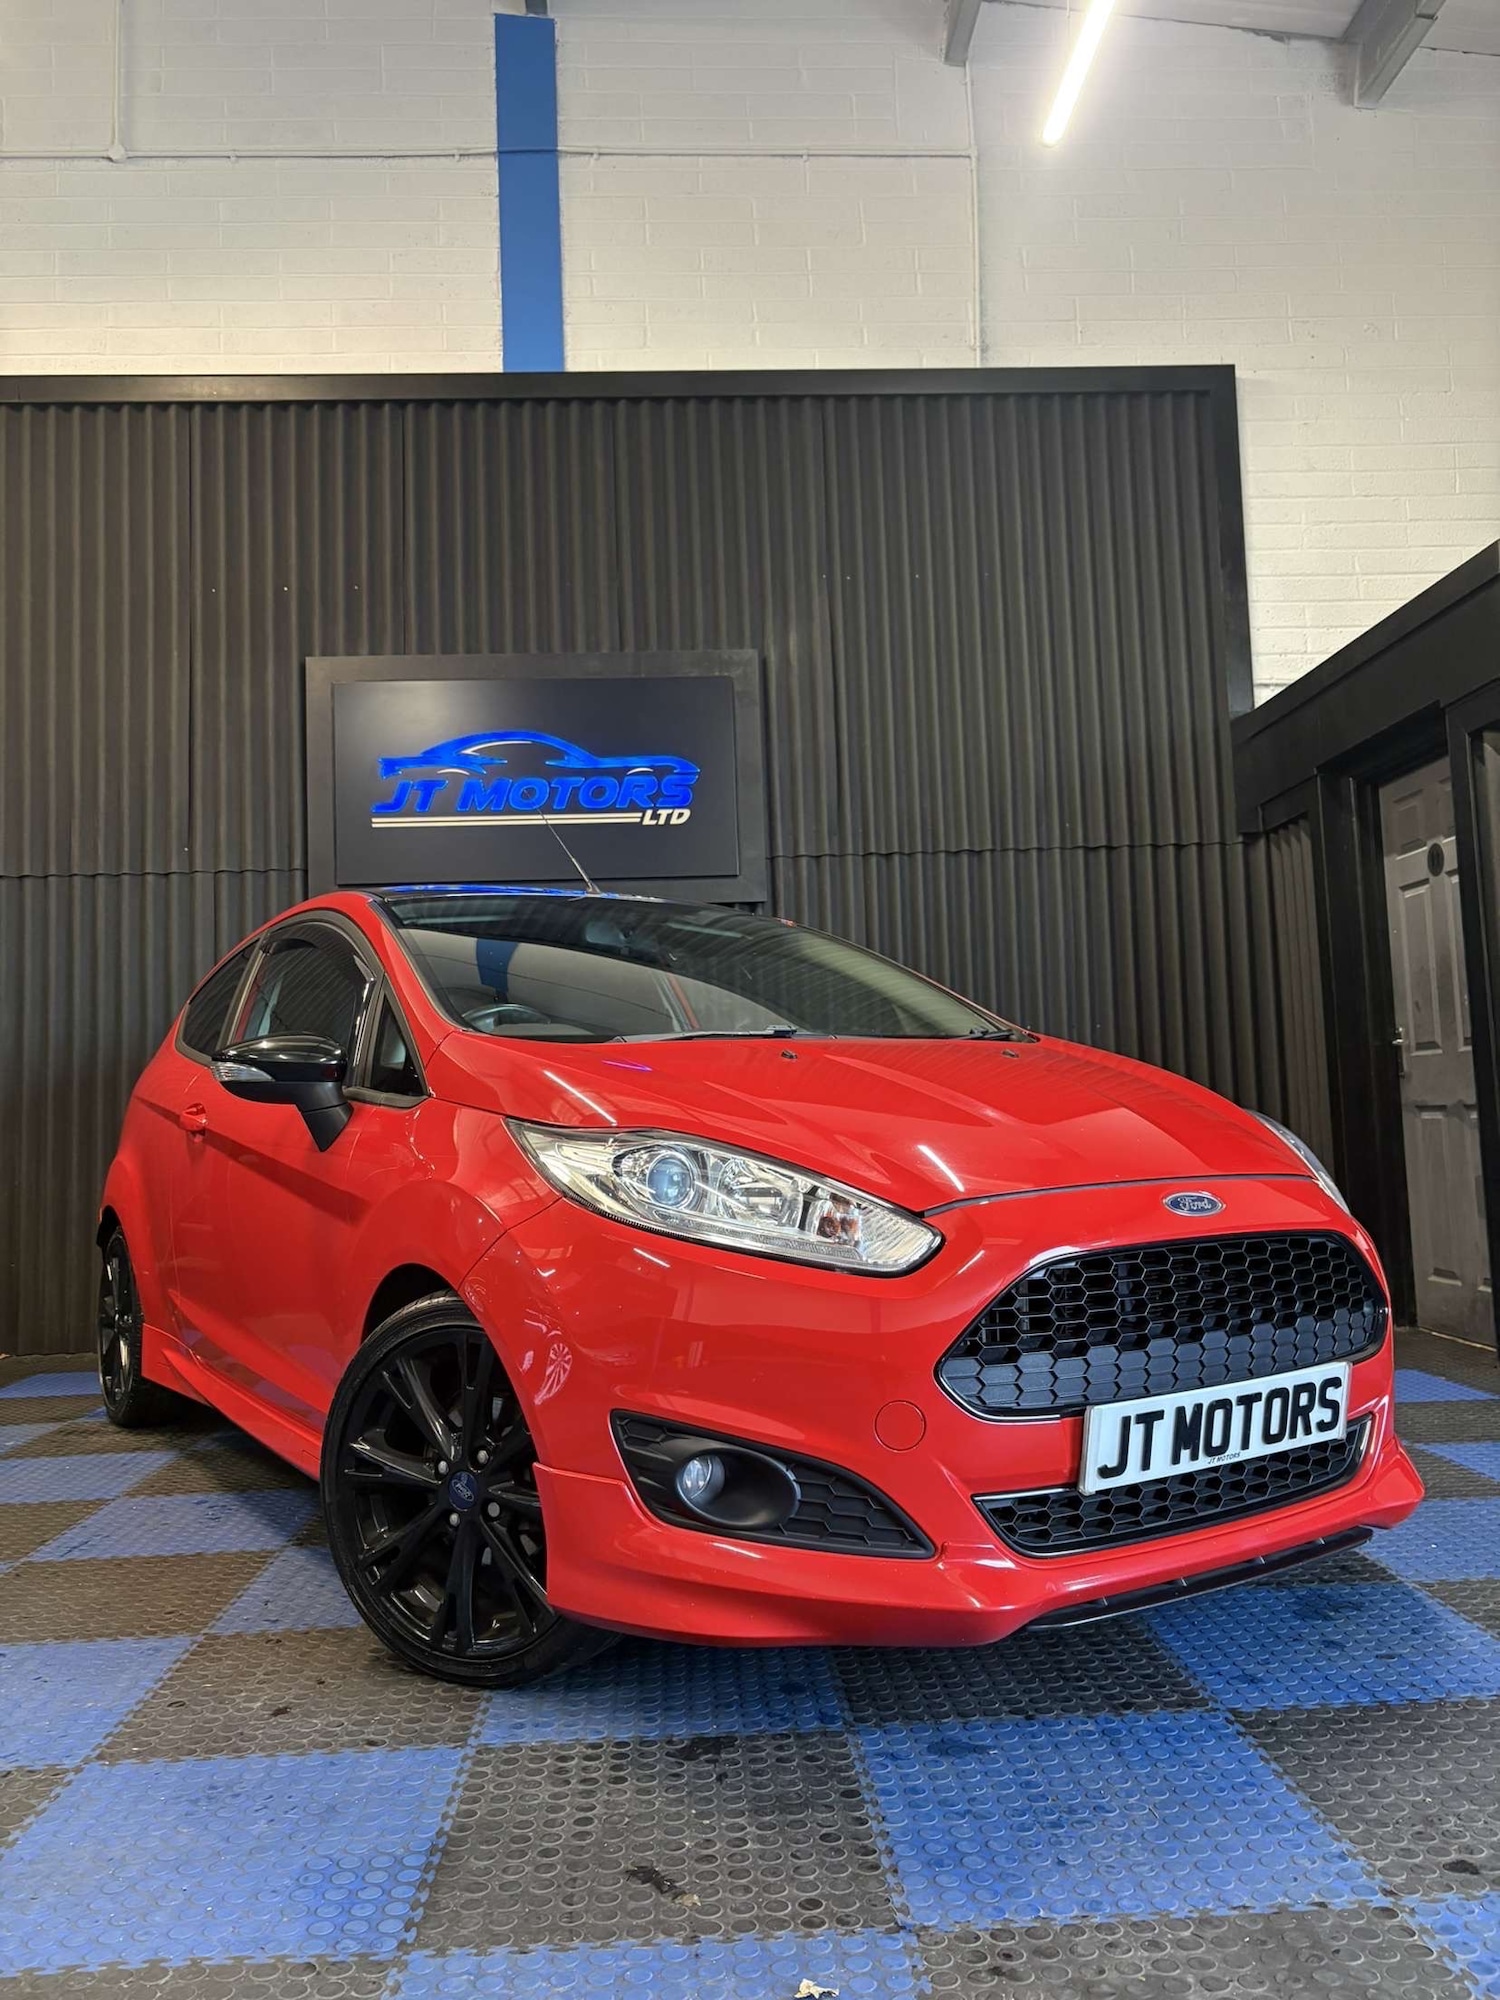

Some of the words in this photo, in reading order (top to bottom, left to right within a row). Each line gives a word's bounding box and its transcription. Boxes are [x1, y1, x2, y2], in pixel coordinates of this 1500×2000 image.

[372, 780, 448, 812] JT
[457, 776, 698, 811] MOTORS
[641, 808, 691, 826] LTD
[1177, 1196, 1212, 1211] Ford
[1097, 1409, 1165, 1479] JT
[1172, 1376, 1342, 1465] MOTORS
[1207, 1457, 1215, 1465] JT
[1216, 1451, 1241, 1463] MOTORS
